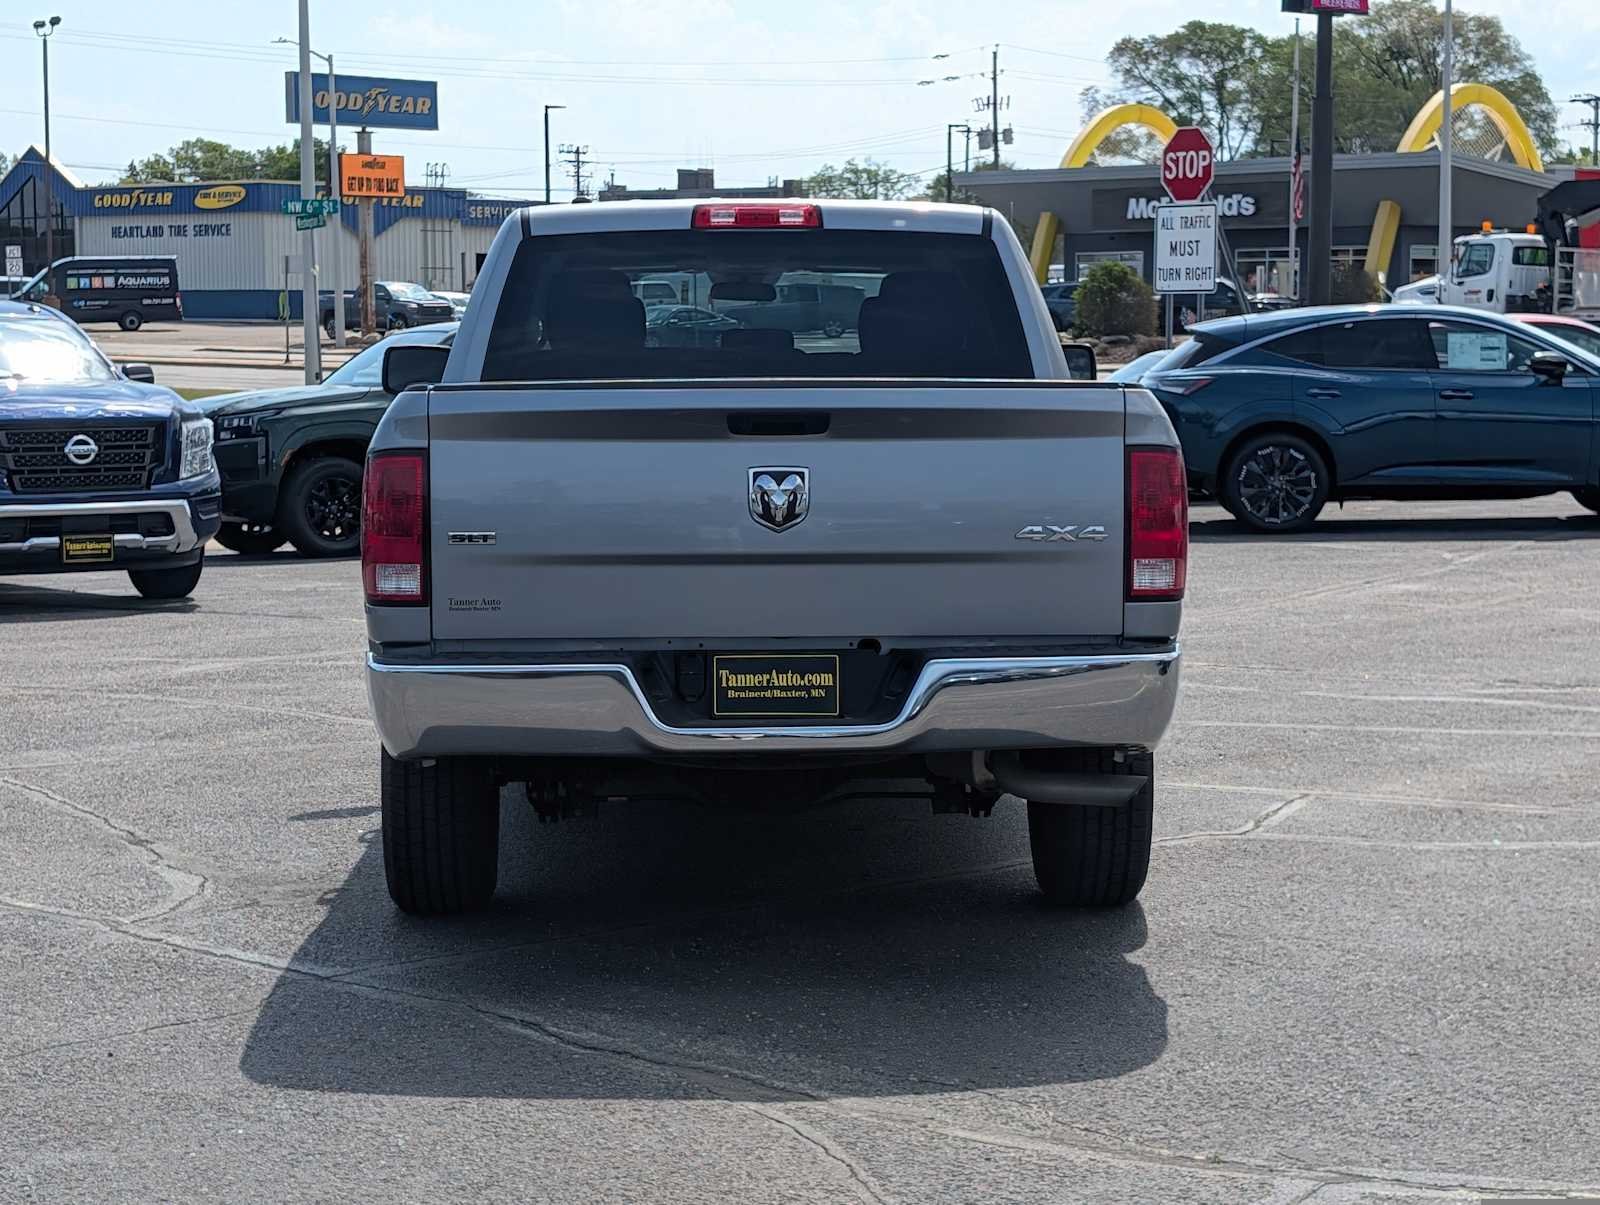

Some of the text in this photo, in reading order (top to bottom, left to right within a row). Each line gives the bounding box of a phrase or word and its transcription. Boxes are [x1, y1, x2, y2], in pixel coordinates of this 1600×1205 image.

[1164, 151, 1210, 180] STOP
[94, 189, 173, 209] GOODYEAR
[287, 201, 302, 213] NW
[1160, 216, 1211, 230] ALL TRAFFIC
[111, 223, 231, 239] HEARTLAND TIRE SERVICE
[1169, 240, 1201, 257] MUST
[1158, 267, 1213, 281] TURN RIGHT
[447, 597, 502, 607] Tanner Auto
[719, 669, 833, 687] TannerAuto.com
[727, 688, 826, 699] Brainerd/Baxter, MN
